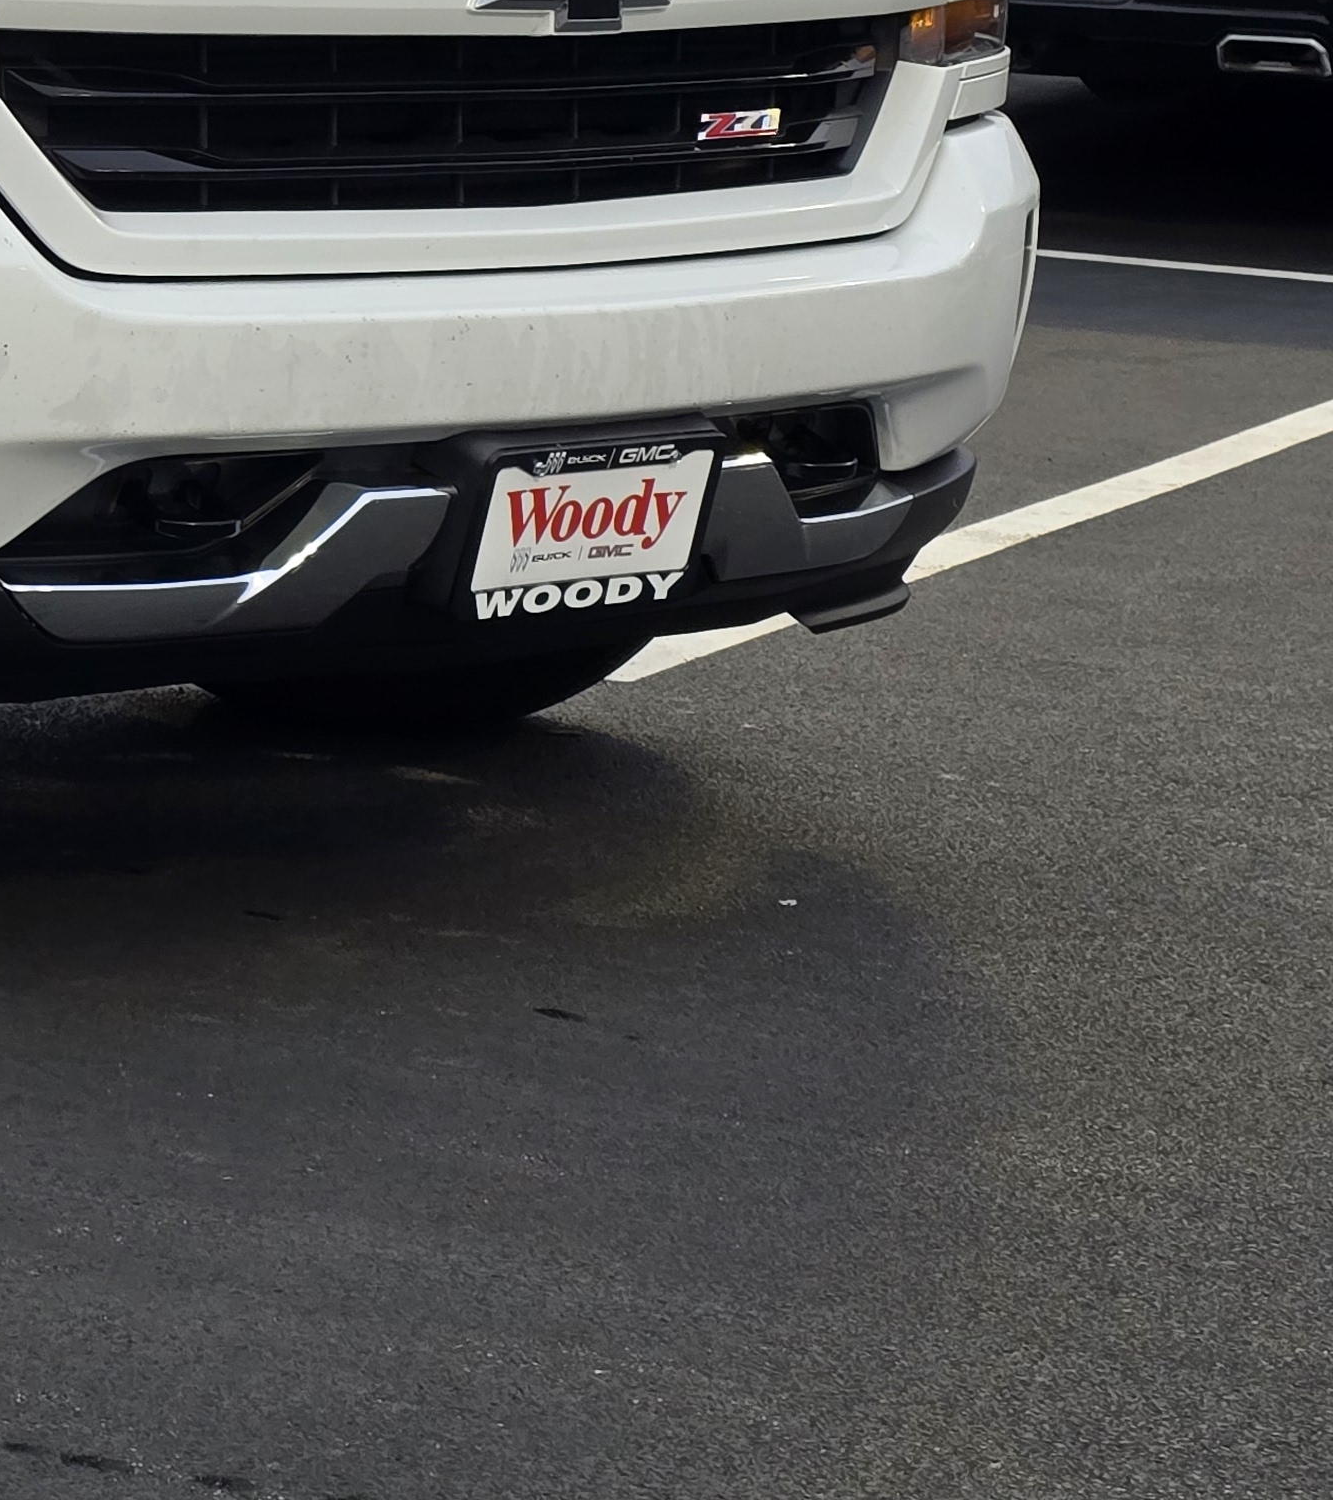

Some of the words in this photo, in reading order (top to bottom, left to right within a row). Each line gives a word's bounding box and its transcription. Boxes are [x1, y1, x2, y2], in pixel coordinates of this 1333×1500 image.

[619, 444, 676, 464] GMC
[507, 478, 688, 549] Woody
[588, 544, 634, 559] GMC
[475, 571, 685, 620] WOODY
